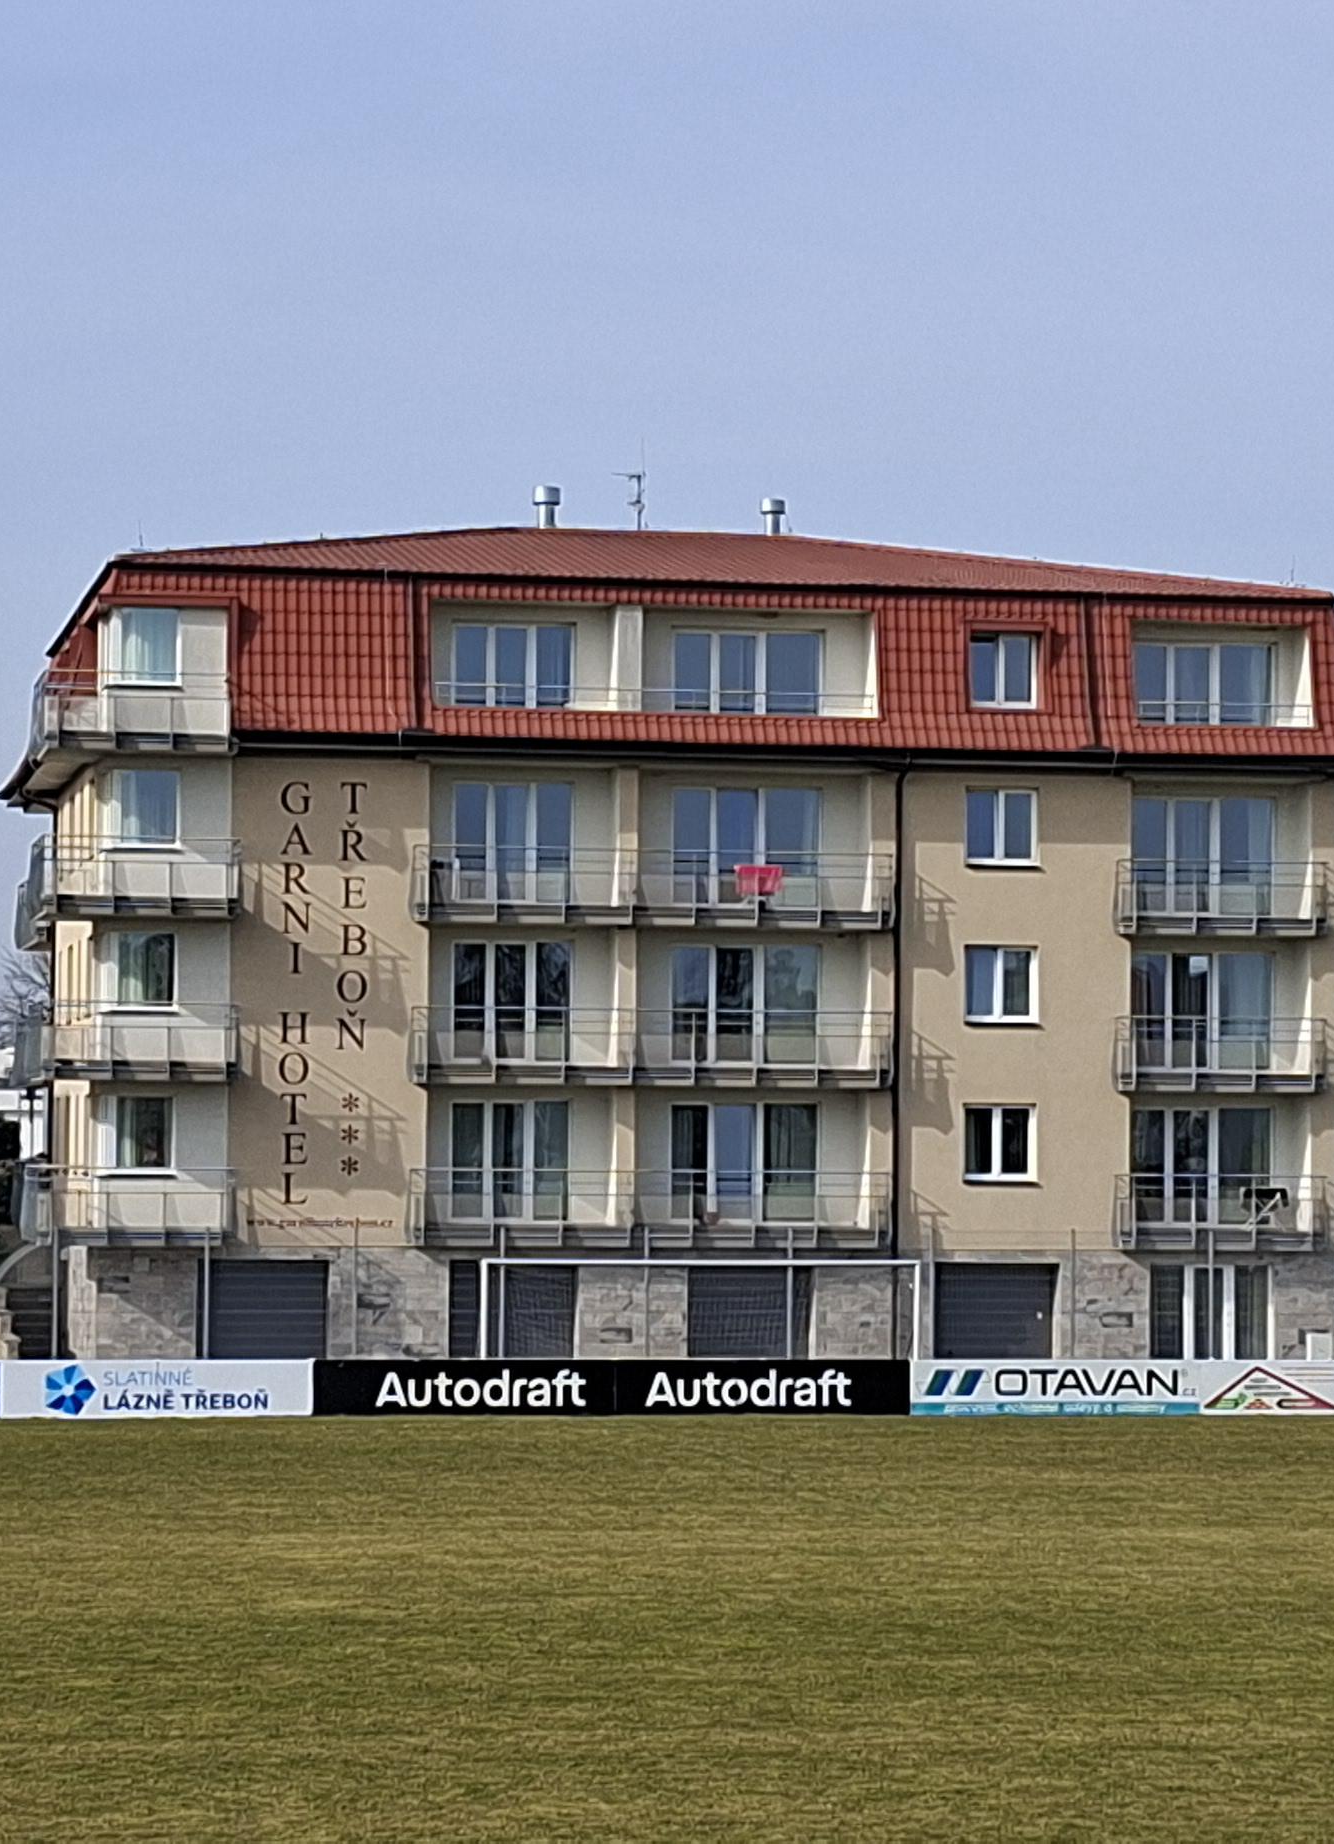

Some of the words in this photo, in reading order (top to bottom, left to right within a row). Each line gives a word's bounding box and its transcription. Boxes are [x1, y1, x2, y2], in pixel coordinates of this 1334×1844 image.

[280, 781, 313, 975] GARNI
[335, 781, 368, 1052] TŘEBOŇ
[278, 1012, 310, 1204] HOTEL
[103, 1368, 193, 1385] SLATINNÉ
[375, 1369, 586, 1407] Autodraft
[645, 1369, 852, 1407] Autodraft
[994, 1369, 1179, 1396] OTAVAN
[103, 1388, 173, 1411] LÁZNĚ
[181, 1388, 269, 1411] TŘEBOŇ
